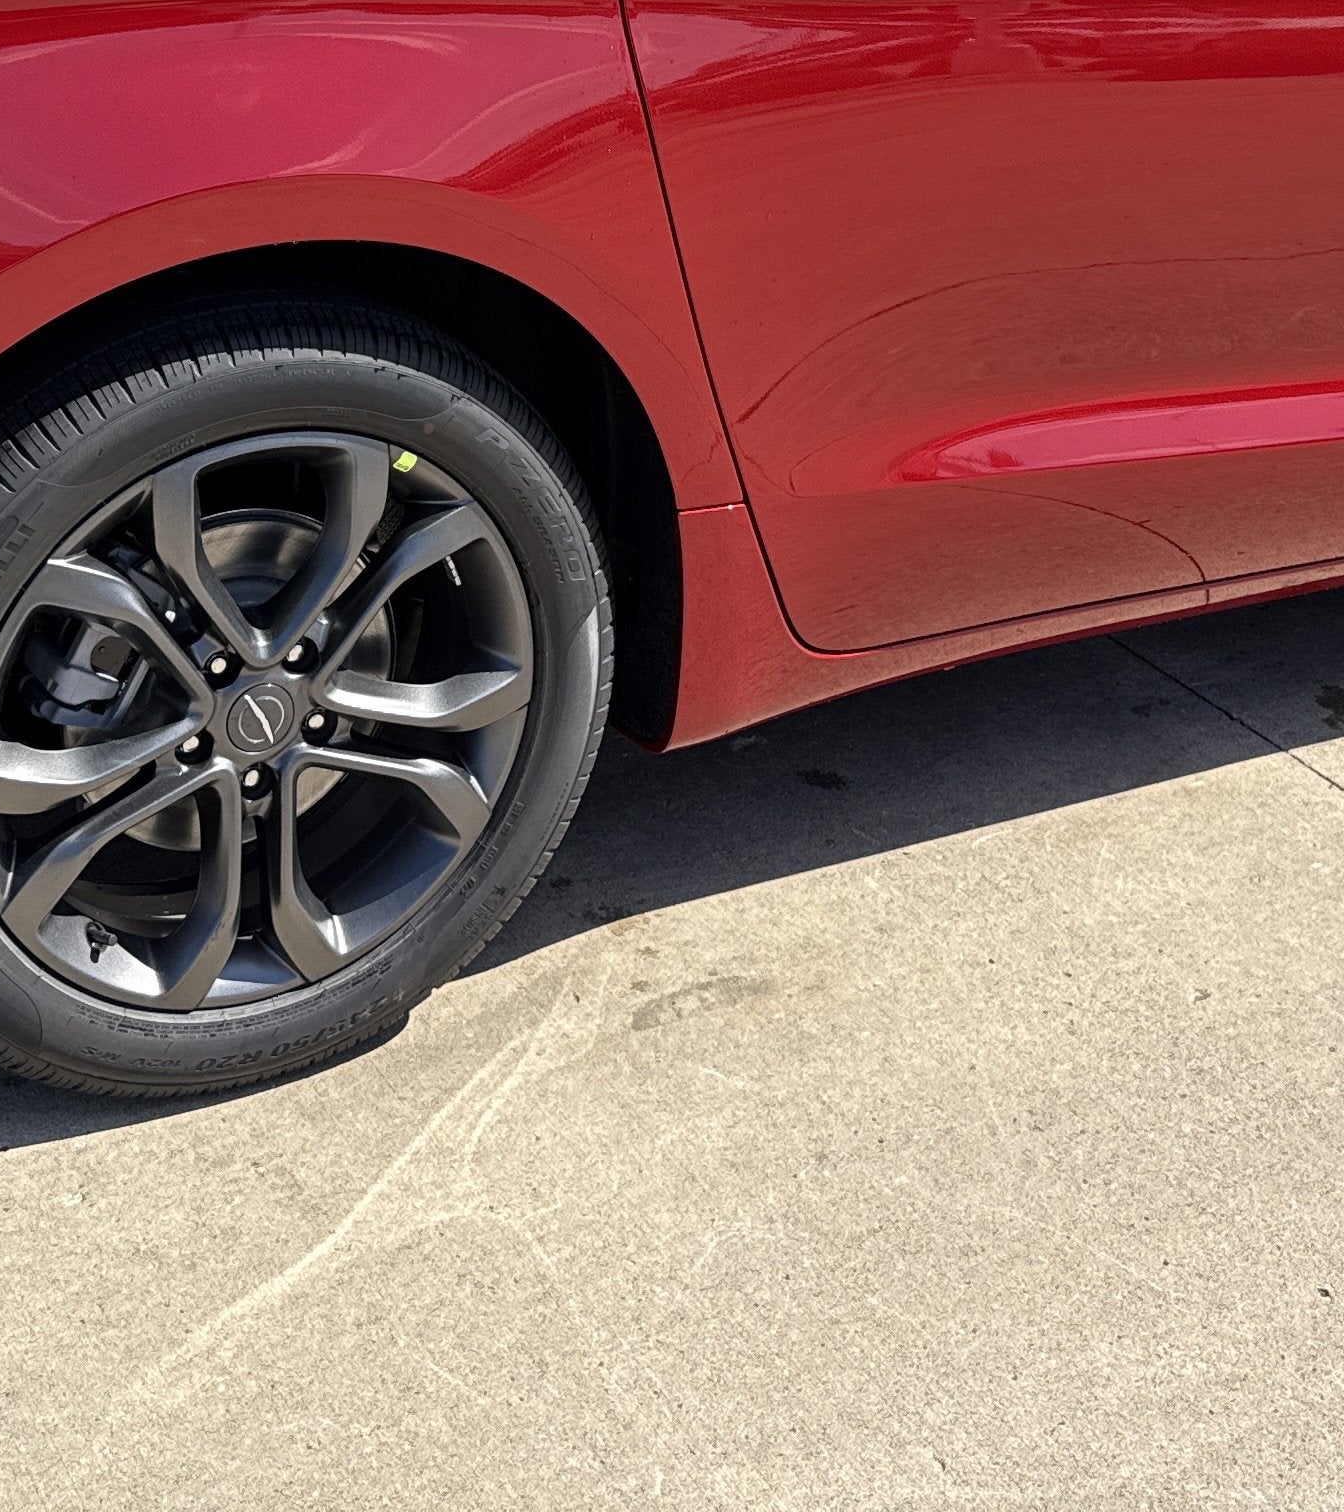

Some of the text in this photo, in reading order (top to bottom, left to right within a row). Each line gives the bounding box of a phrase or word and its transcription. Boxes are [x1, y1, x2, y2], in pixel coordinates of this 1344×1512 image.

[475, 426, 587, 582] P ZERO
[128, 1057, 182, 1068] 102V
[195, 1050, 264, 1072] R20
